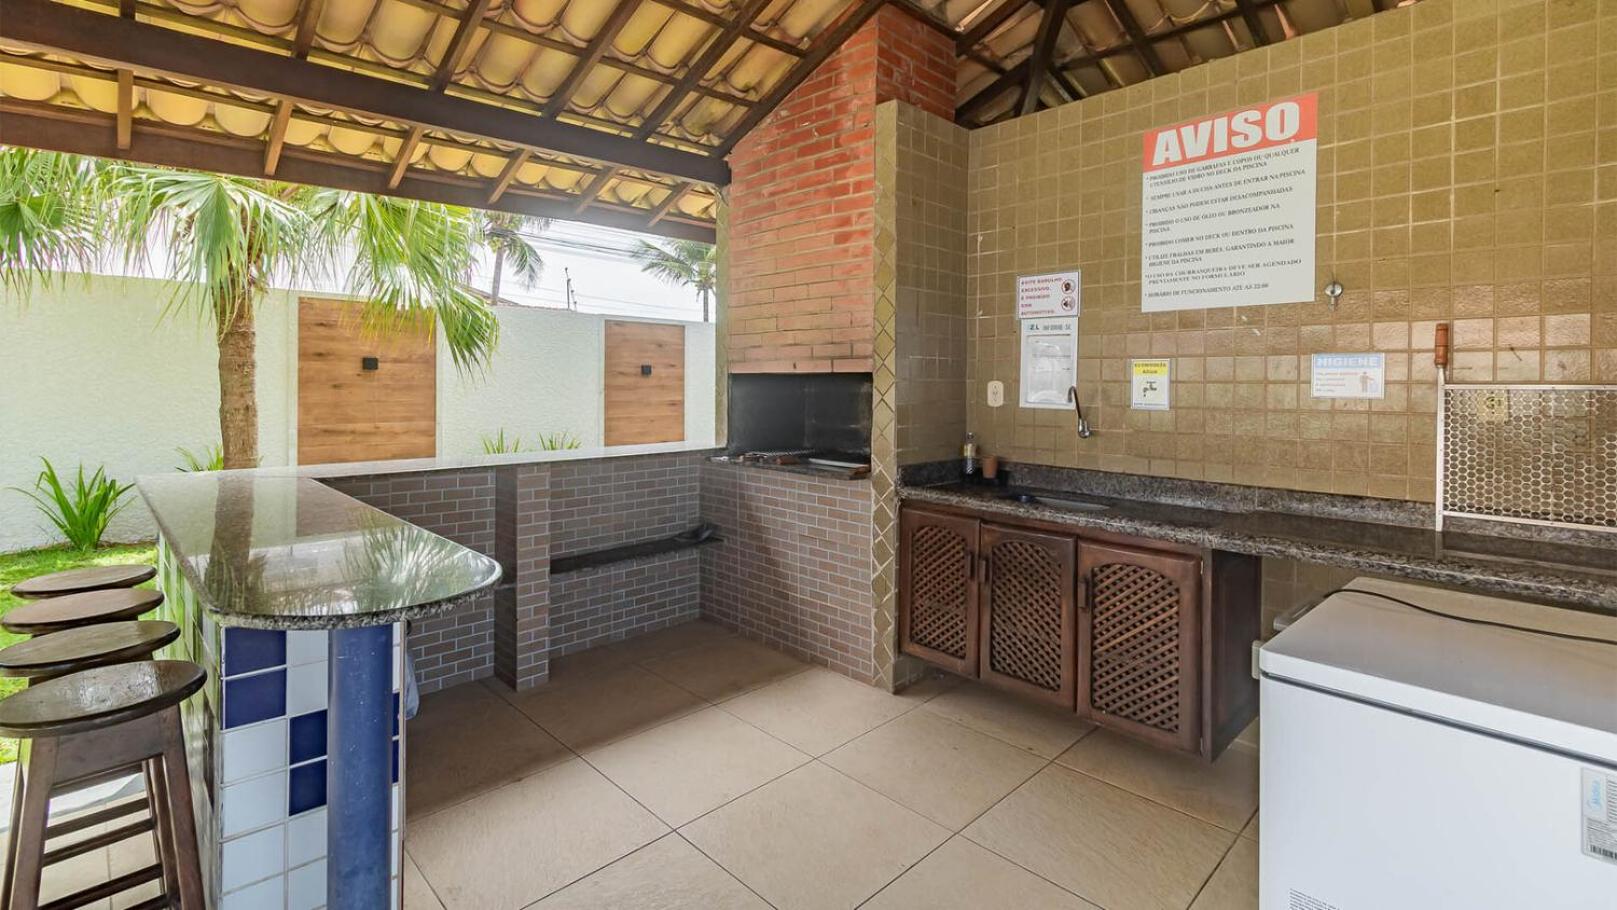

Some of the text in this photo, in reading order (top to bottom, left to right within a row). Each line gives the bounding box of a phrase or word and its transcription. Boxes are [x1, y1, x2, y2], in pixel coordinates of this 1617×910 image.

[1152, 101, 1300, 166] AVISO
[1264, 148, 1299, 159] QUALQUER
[1243, 161, 1267, 170] PISCINA
[1243, 175, 1268, 184] ENTRAR
[1280, 169, 1305, 178] PISCINA
[1230, 186, 1293, 201] DESACOMPANHADAS
[1149, 219, 1174, 227] PROIBIDO
[1228, 205, 1269, 216] BRONZEADOR
[1175, 236, 1194, 244] COMER
[1231, 228, 1257, 237] DENTRO
[1268, 224, 1293, 232] PISCINA
[1225, 242, 1266, 251] GARANTINDO
[1273, 238, 1294, 246] MAIOR
[1180, 256, 1202, 264] PISCINA
[1263, 258, 1301, 267] AGENDADO
[1149, 276, 1189, 285] PREVIAMENTE
[1181, 286, 1231, 295] FUNCIONAMENTO
[1315, 356, 1379, 367] HIGIENE
